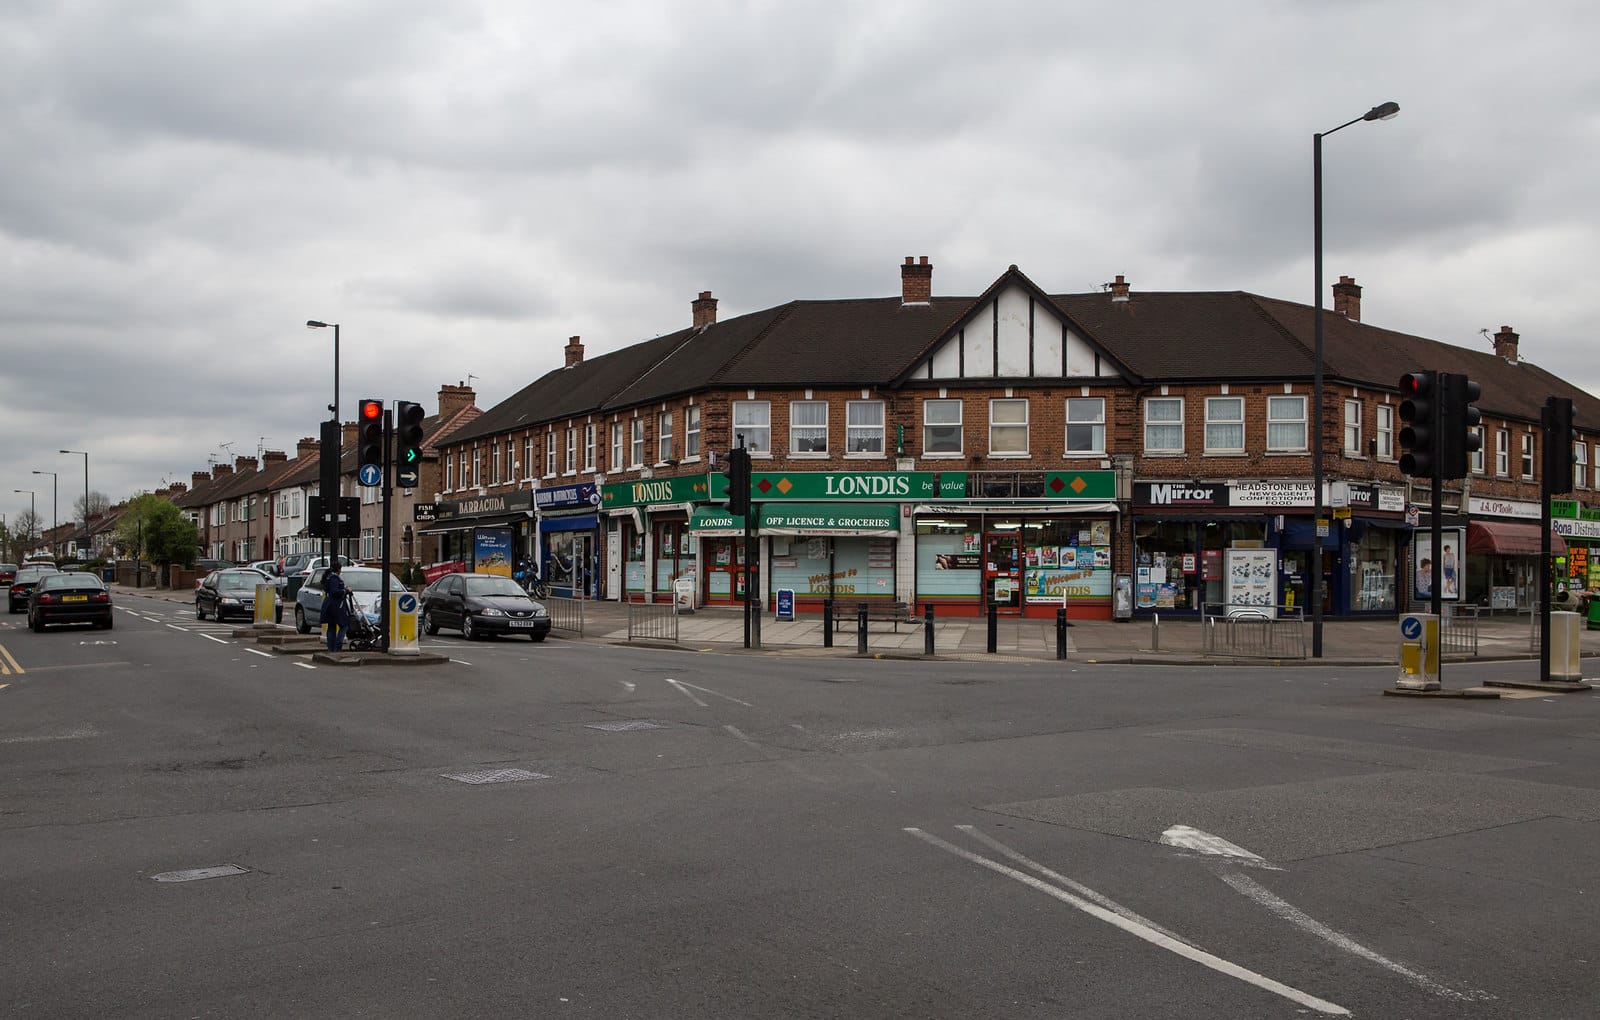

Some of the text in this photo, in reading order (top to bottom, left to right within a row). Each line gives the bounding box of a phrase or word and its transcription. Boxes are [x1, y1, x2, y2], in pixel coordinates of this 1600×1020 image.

[632, 481, 673, 503] LONDIS
[825, 476, 964, 495] LONDIS be value
[1150, 484, 1213, 504] Mirror
[1235, 483, 1316, 491] HEADSTONE NEW
[1348, 486, 1371, 504] irror
[459, 497, 505, 514] BARRACUDA
[700, 518, 733, 527] LONDIS
[766, 517, 890, 527] OFF LICENCE & GROCERIES
[1553, 520, 1572, 534] Bona
